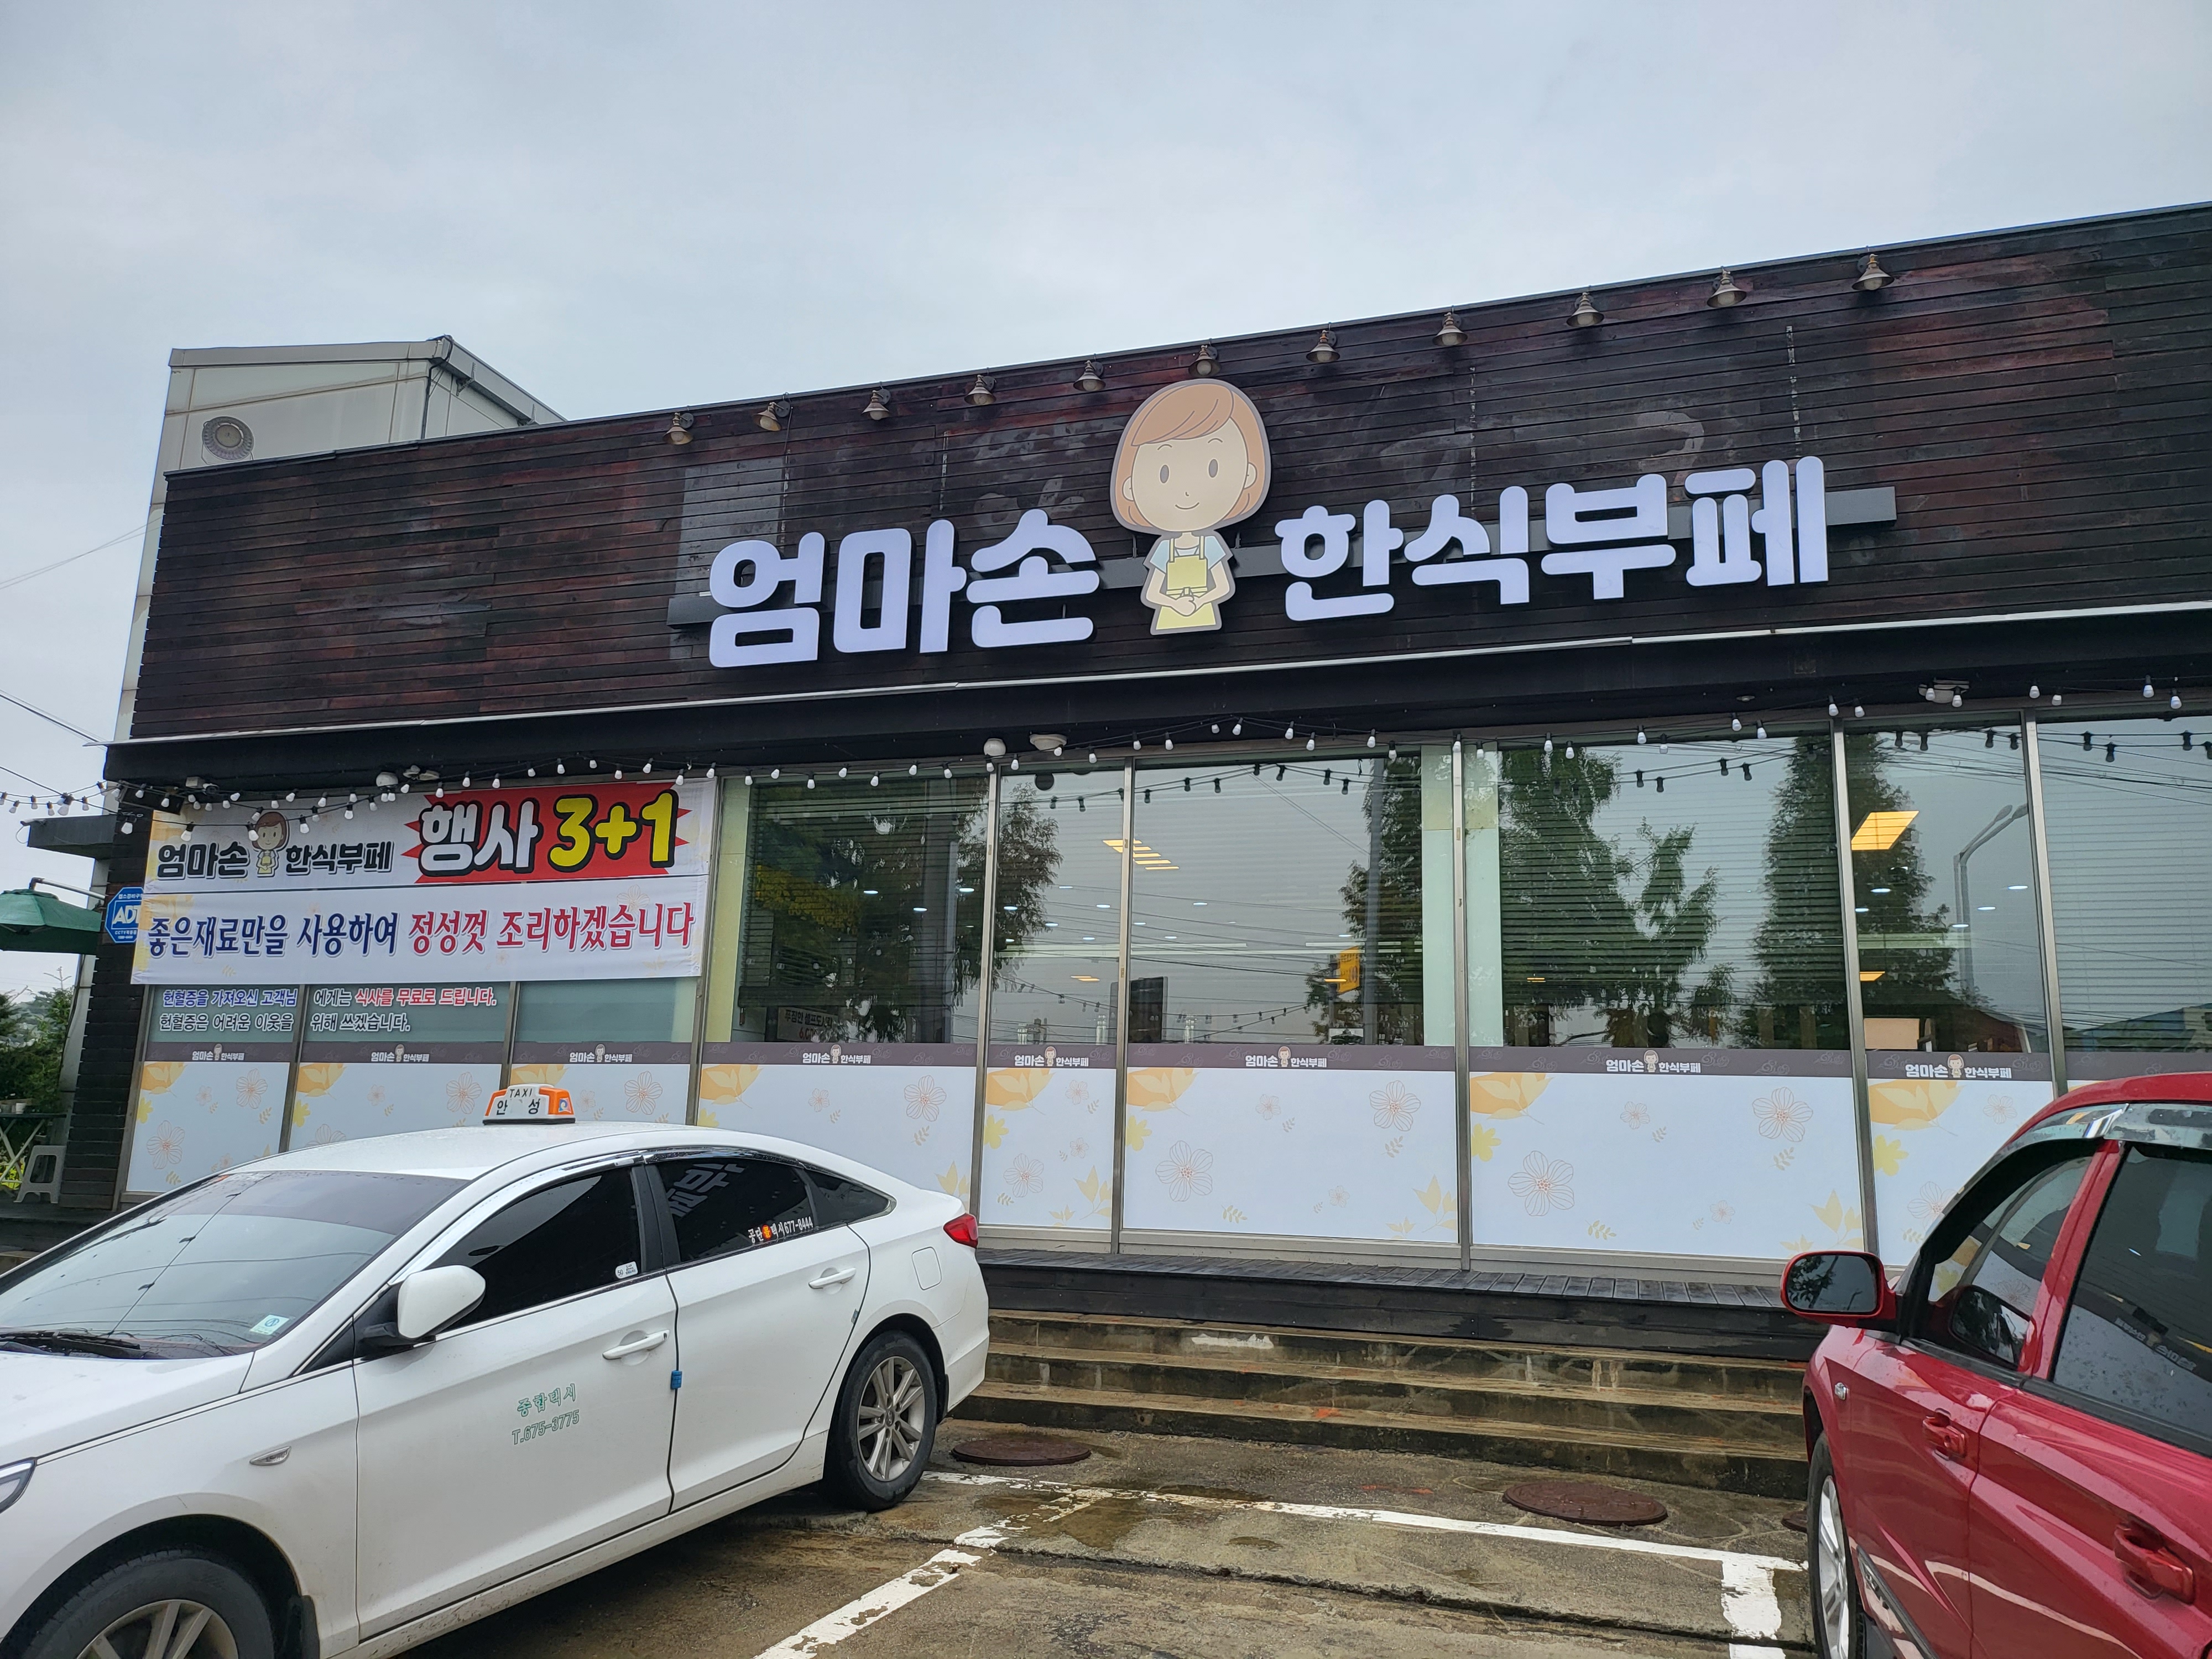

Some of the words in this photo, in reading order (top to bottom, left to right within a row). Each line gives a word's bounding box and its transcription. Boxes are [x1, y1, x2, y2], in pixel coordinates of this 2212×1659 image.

[709, 508, 1100, 667] 엄마손
[1275, 456, 1828, 621] 한식부페
[419, 798, 543, 876] 행사
[548, 790, 678, 872] 3+1
[157, 841, 249, 879] 엄마손
[285, 841, 394, 875] 한식부페
[113, 905, 141, 924] ADT
[148, 914, 289, 957] 좋은재료만을
[297, 911, 399, 956] 사용하여
[408, 909, 489, 954] 정성껏
[496, 901, 695, 951] 조리하겠습니다
[163, 989, 209, 1008] 헌혈증을
[211, 988, 259, 1007] 가져오신
[260, 988, 298, 1007] 고객님
[314, 988, 352, 1006] 에게는
[355, 988, 394, 1006] 식사를
[397, 988, 436, 1006] 무료로
[439, 987, 497, 1006] 드립니다.
[159, 1013, 208, 1032] 헌혈증은
[213, 1013, 251, 1032] 어려운
[255, 1013, 294, 1032] 이웃을
[310, 1013, 338, 1032] 위해
[339, 1012, 411, 1032] 쓰겠습니다.
[570, 1052, 595, 1062] 엄마손
[604, 1053, 633, 1062] 한식부페
[802, 1052, 831, 1063] 엄마손
[841, 1055, 872, 1064] 한식부페
[1014, 1055, 1045, 1066] 엄마손
[1056, 1057, 1089, 1067] 한식부페
[1245, 1055, 1279, 1067] 엄마손
[1290, 1057, 1327, 1068] 한식부페
[1606, 1059, 1645, 1072] 엄마손
[1658, 1062, 1701, 1073] 한식부페
[1905, 1064, 1949, 1078] 엄마손
[1964, 1067, 2012, 1078] 한식부페
[509, 1088, 533, 1098] TAXI
[517, 1383, 576, 1417] 종합택시
[512, 1409, 580, 1445] T.675-3775
